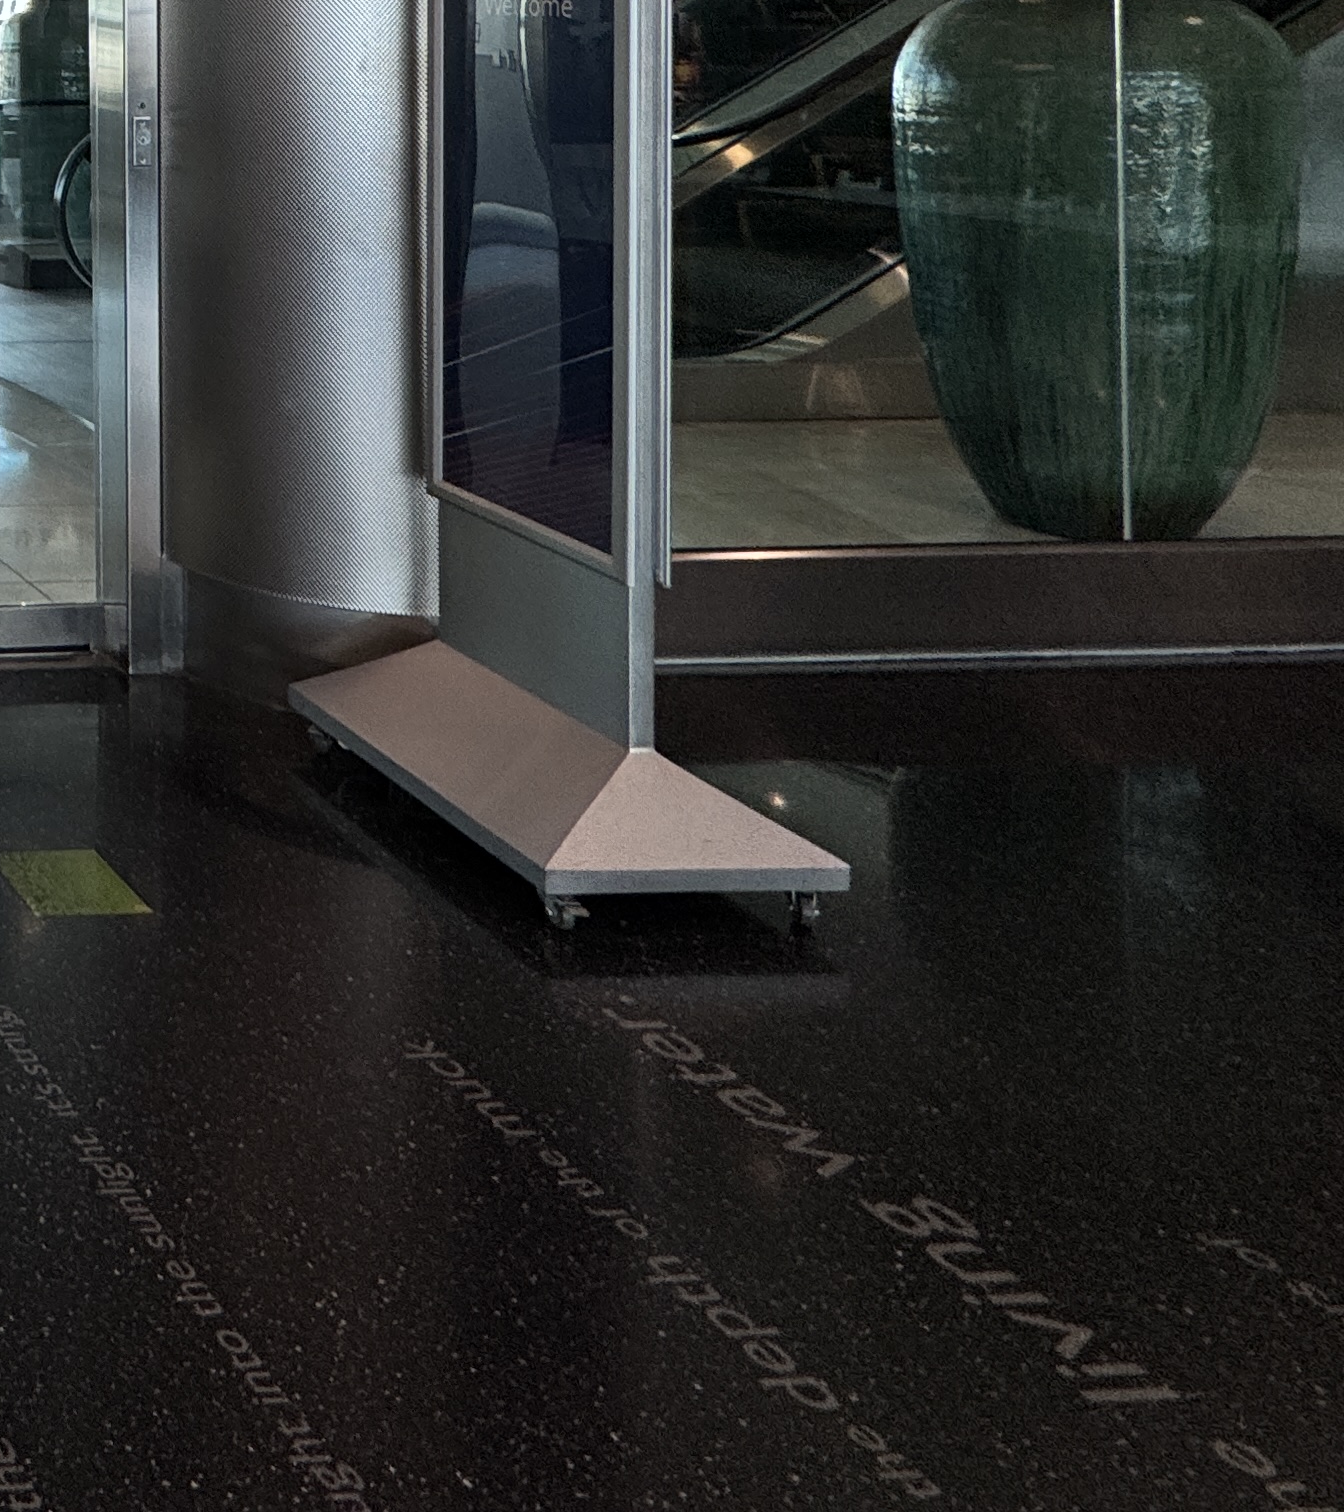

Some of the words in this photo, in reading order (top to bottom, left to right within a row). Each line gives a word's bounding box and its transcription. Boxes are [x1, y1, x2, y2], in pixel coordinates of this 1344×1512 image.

[401, 1037, 536, 1144] muck
[538, 1148, 607, 1202] the
[590, 1201, 649, 1242] of
[165, 1257, 223, 1318] the
[860, 1195, 1180, 1404] living
[216, 1326, 291, 1408] into
[645, 1253, 841, 1414] depth
[846, 1421, 944, 1502] the
